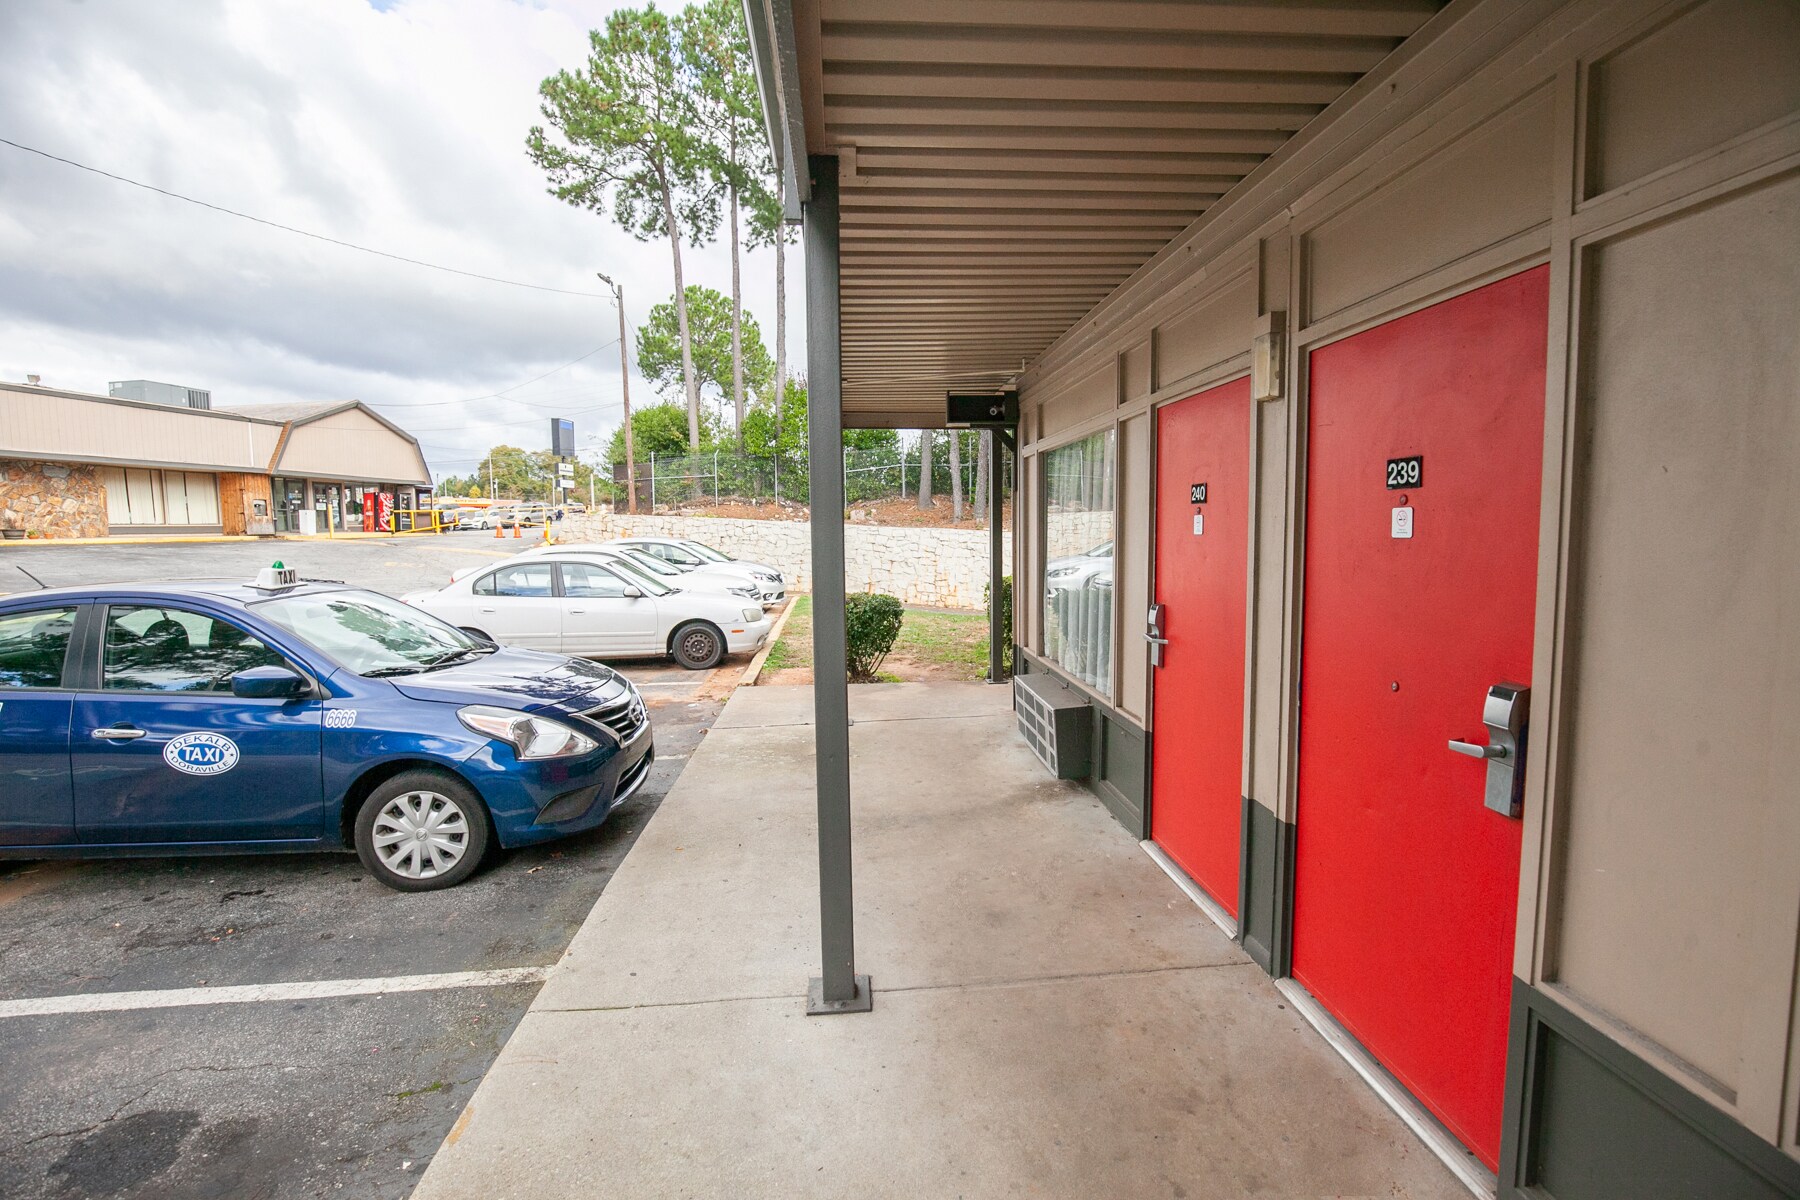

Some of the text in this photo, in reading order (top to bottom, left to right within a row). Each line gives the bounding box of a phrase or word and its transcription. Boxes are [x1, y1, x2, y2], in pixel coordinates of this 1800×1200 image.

[1387, 460, 1419, 485] 239
[1191, 485, 1206, 501] 240
[277, 569, 296, 585] TAXI
[326, 709, 357, 728] 6666
[172, 735, 231, 752] DEKALB
[182, 746, 220, 762] TAXI
[170, 756, 231, 773] DORAVILLE
